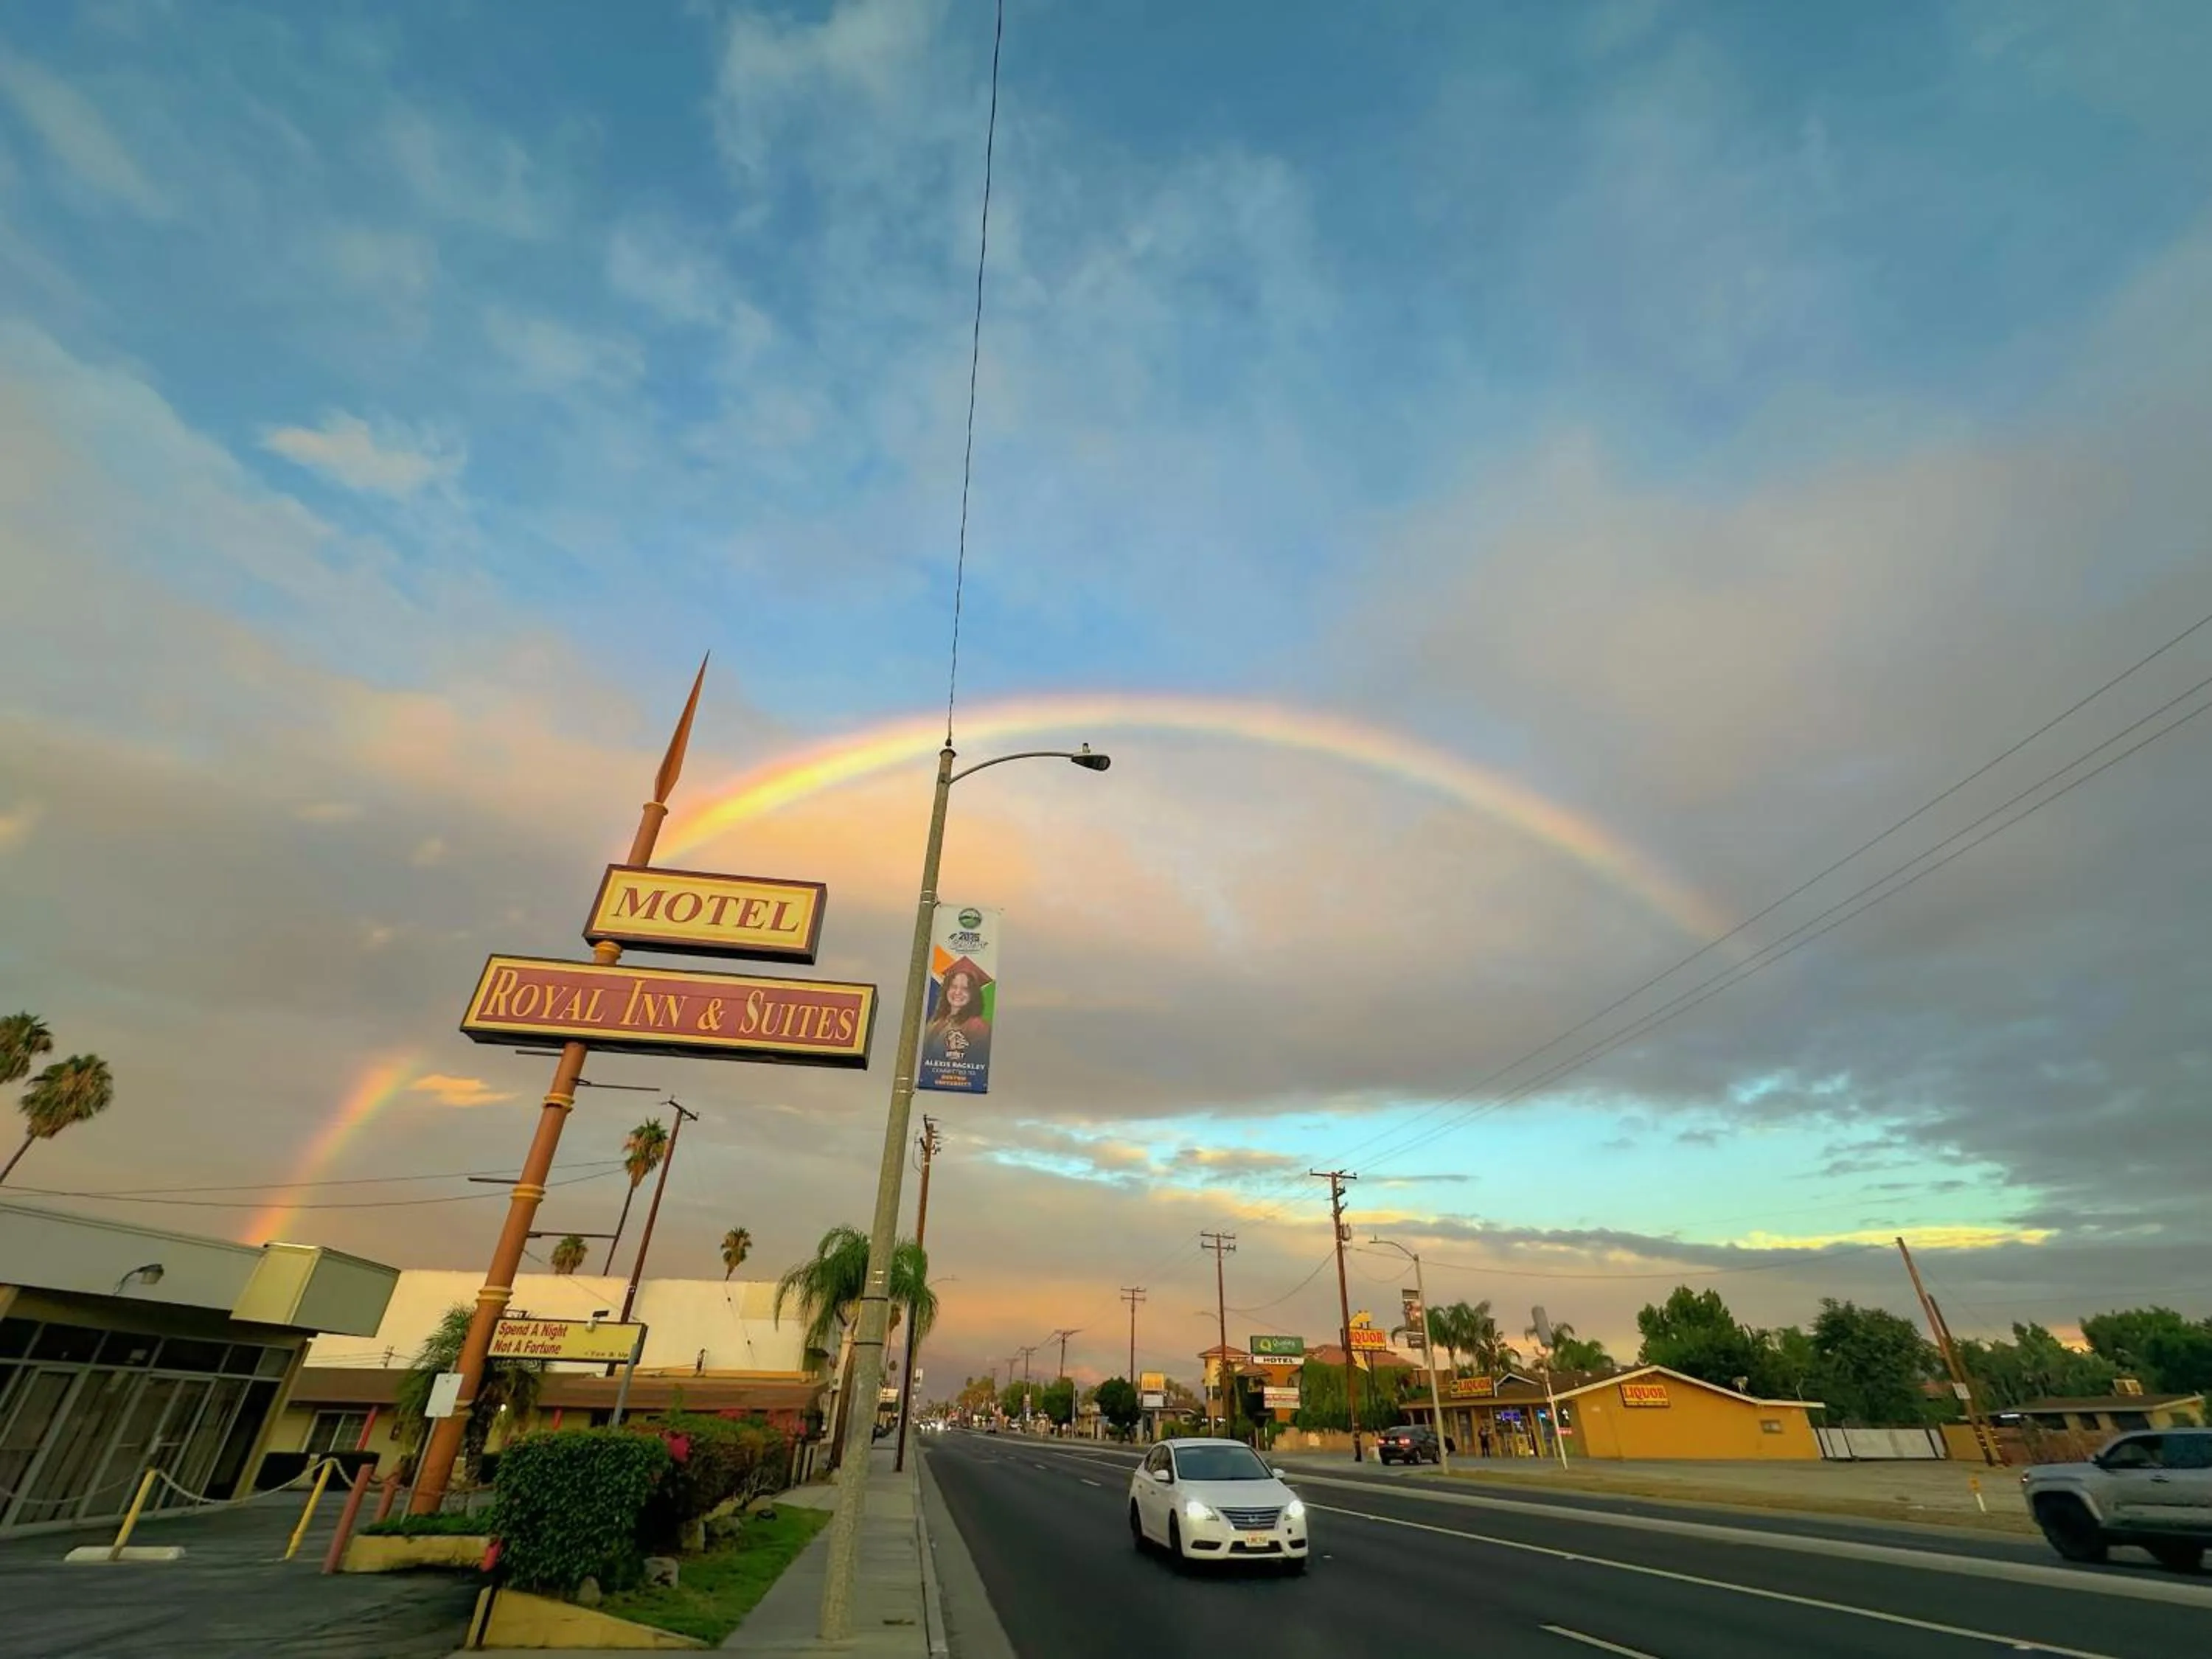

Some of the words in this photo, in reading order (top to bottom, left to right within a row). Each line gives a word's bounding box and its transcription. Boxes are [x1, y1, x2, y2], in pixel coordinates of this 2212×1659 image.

[612, 887, 801, 933] MOTEL
[482, 970, 607, 1024] ROYAL
[619, 979, 688, 1028] INN
[697, 998, 726, 1032] &
[738, 990, 855, 1041] SUITES
[498, 1321, 528, 1338] Spend
[530, 1325, 539, 1337] A
[540, 1325, 568, 1340] Night
[1350, 1331, 1384, 1344] IQUOR
[493, 1339, 512, 1352] Not
[514, 1340, 523, 1352] A
[524, 1340, 563, 1355] Fortune
[1459, 1380, 1490, 1391] LIQUOR
[1624, 1387, 1666, 1399] LIQUOR
